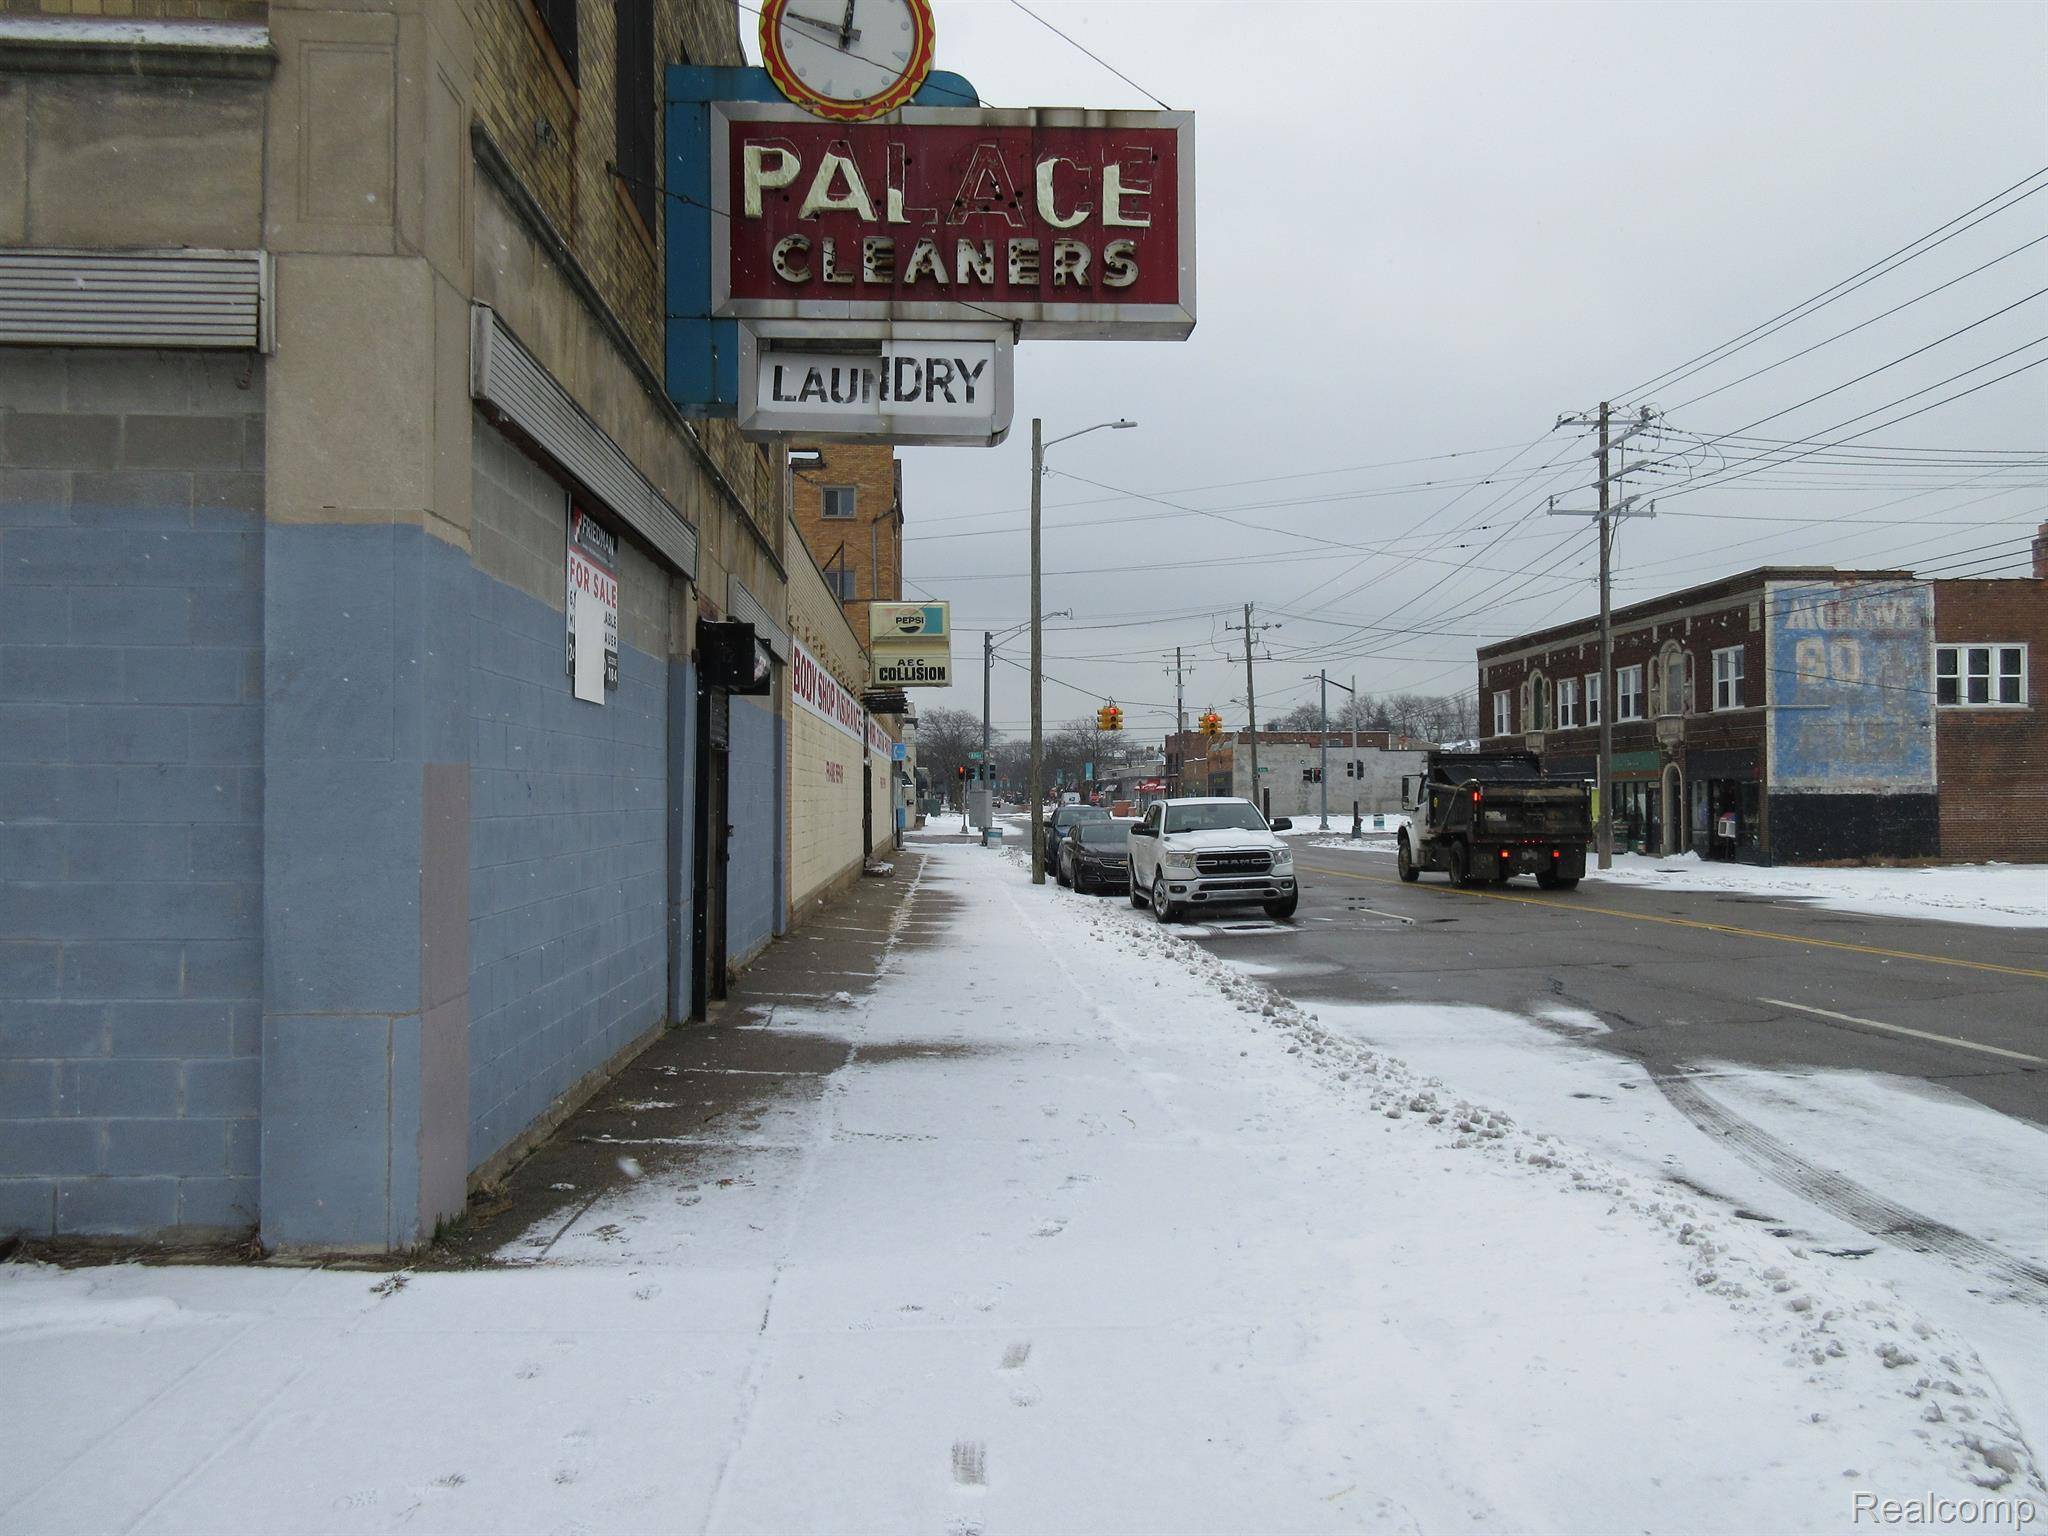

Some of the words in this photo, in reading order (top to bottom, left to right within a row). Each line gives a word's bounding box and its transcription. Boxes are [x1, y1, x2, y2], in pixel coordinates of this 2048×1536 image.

[743, 137, 1152, 229] PALACE
[773, 234, 1140, 288] CLEANERS
[773, 356, 989, 406] LAUNDRY
[582, 513, 614, 557] FRIEDMAN
[569, 556, 590, 594] FOR
[593, 573, 617, 609] SALE
[895, 616, 925, 624] PEPSI
[793, 645, 817, 706] BODY
[818, 671, 835, 718] SHOP
[879, 666, 946, 681] COLLISION
